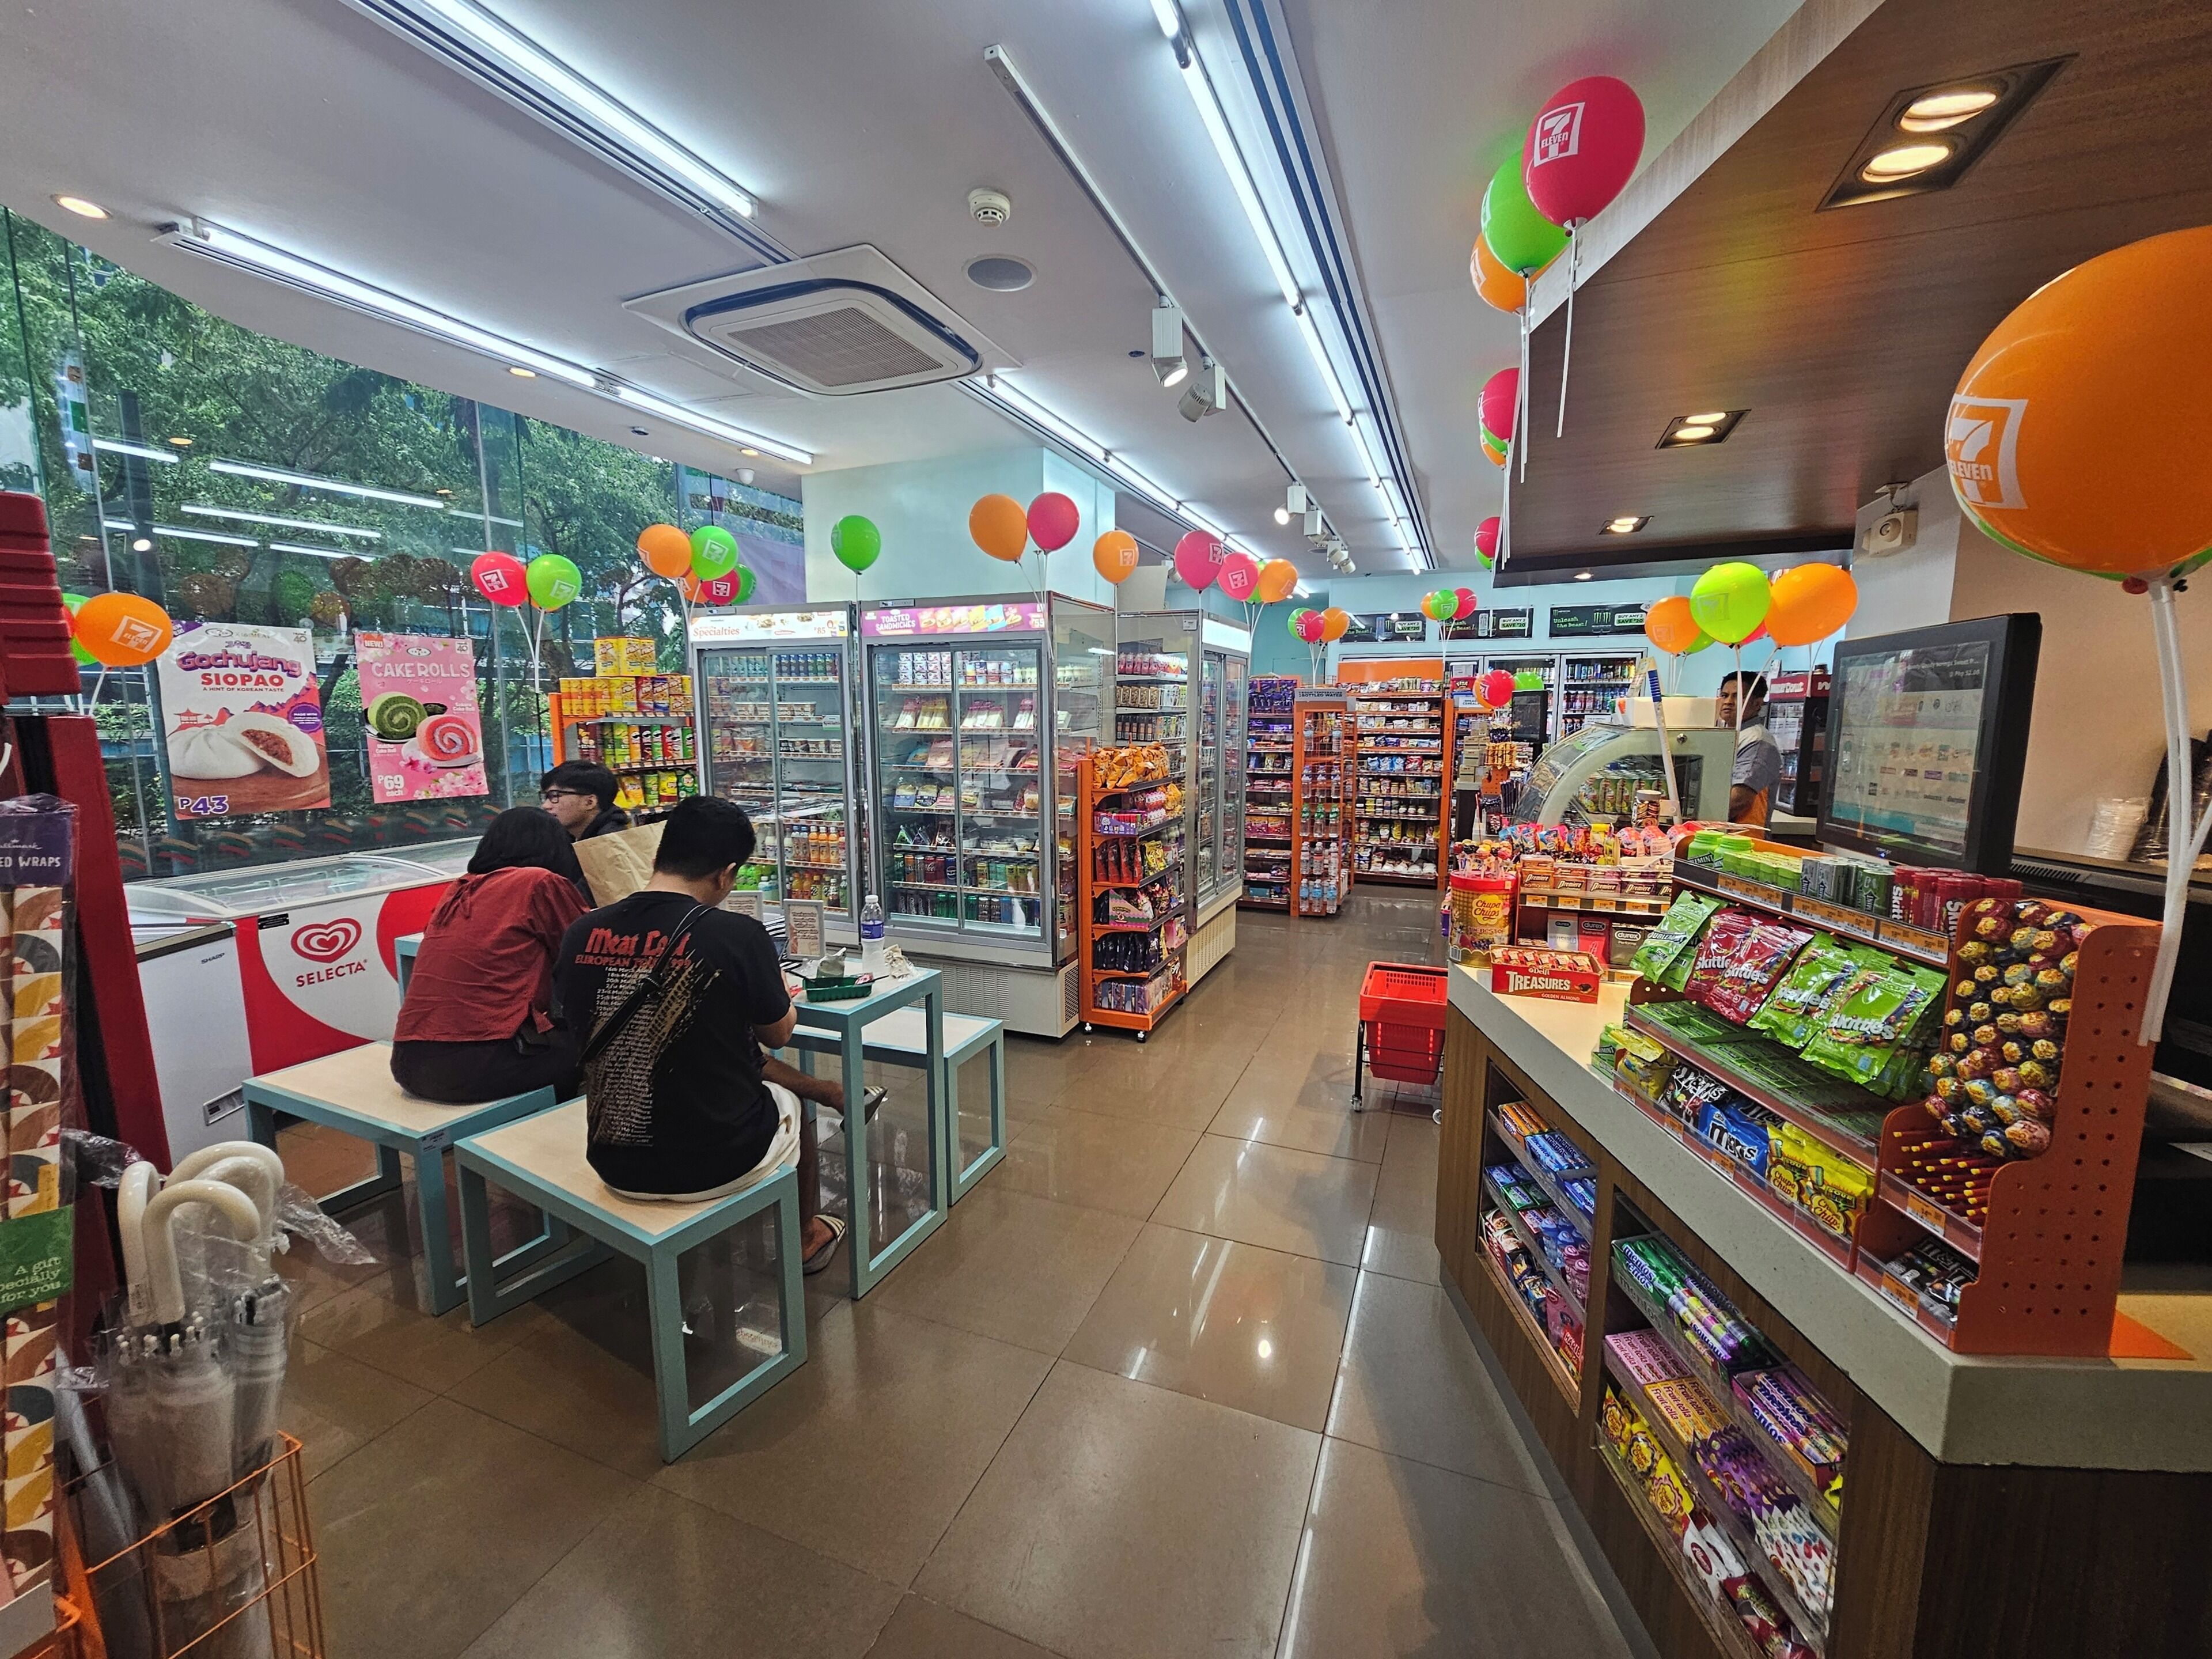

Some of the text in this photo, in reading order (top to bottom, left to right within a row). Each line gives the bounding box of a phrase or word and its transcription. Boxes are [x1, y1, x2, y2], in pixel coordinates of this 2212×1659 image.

[1541, 132, 1569, 149] ELEVEN
[1948, 460, 1993, 481] ELEVEN
[875, 620, 916, 631] SANDWICHES
[882, 613, 911, 624] TOASTED
[123, 633, 148, 645] ELEVEN
[693, 627, 740, 639] Specialties
[364, 639, 384, 649] NEW!
[176, 649, 302, 678] Gochujang
[371, 662, 471, 679] CAKE ROLLS
[200, 672, 284, 687] SIOPAO
[386, 788, 404, 797] each
[18, 857, 61, 869] WRAPS
[1525, 873, 1550, 884] Premiere
[1557, 879, 1582, 891] Premiere
[1591, 882, 1616, 893] Premiere
[1625, 884, 1653, 895] Premiere
[1475, 899, 1501, 910] Chupa
[1474, 907, 1499, 921] Chups
[585, 927, 640, 956] Meat
[200, 953, 226, 964] SHARP
[575, 954, 630, 967] EUROPEAN
[1656, 949, 1669, 960] GUM
[296, 961, 365, 987] SELECTA
[1724, 962, 1770, 984] Skittles
[1506, 970, 1571, 993] TREASURES
[1830, 1013, 1896, 1040] Skittles
[1547, 1136, 1567, 1157] mentos
[1555, 1135, 1577, 1157] mentos
[1785, 1158, 1808, 1171] SOUR
[1774, 1170, 1796, 1188] Chupa
[1772, 1177, 1795, 1198] Chups
[1827, 1185, 1855, 1201] SOUR
[1813, 1205, 1842, 1230] Chups
[15, 1266, 28, 1275] A
[1624, 1246, 1656, 1281] mentos
[0, 1281, 61, 1303] for you
[1691, 1323, 1728, 1359] mentos
